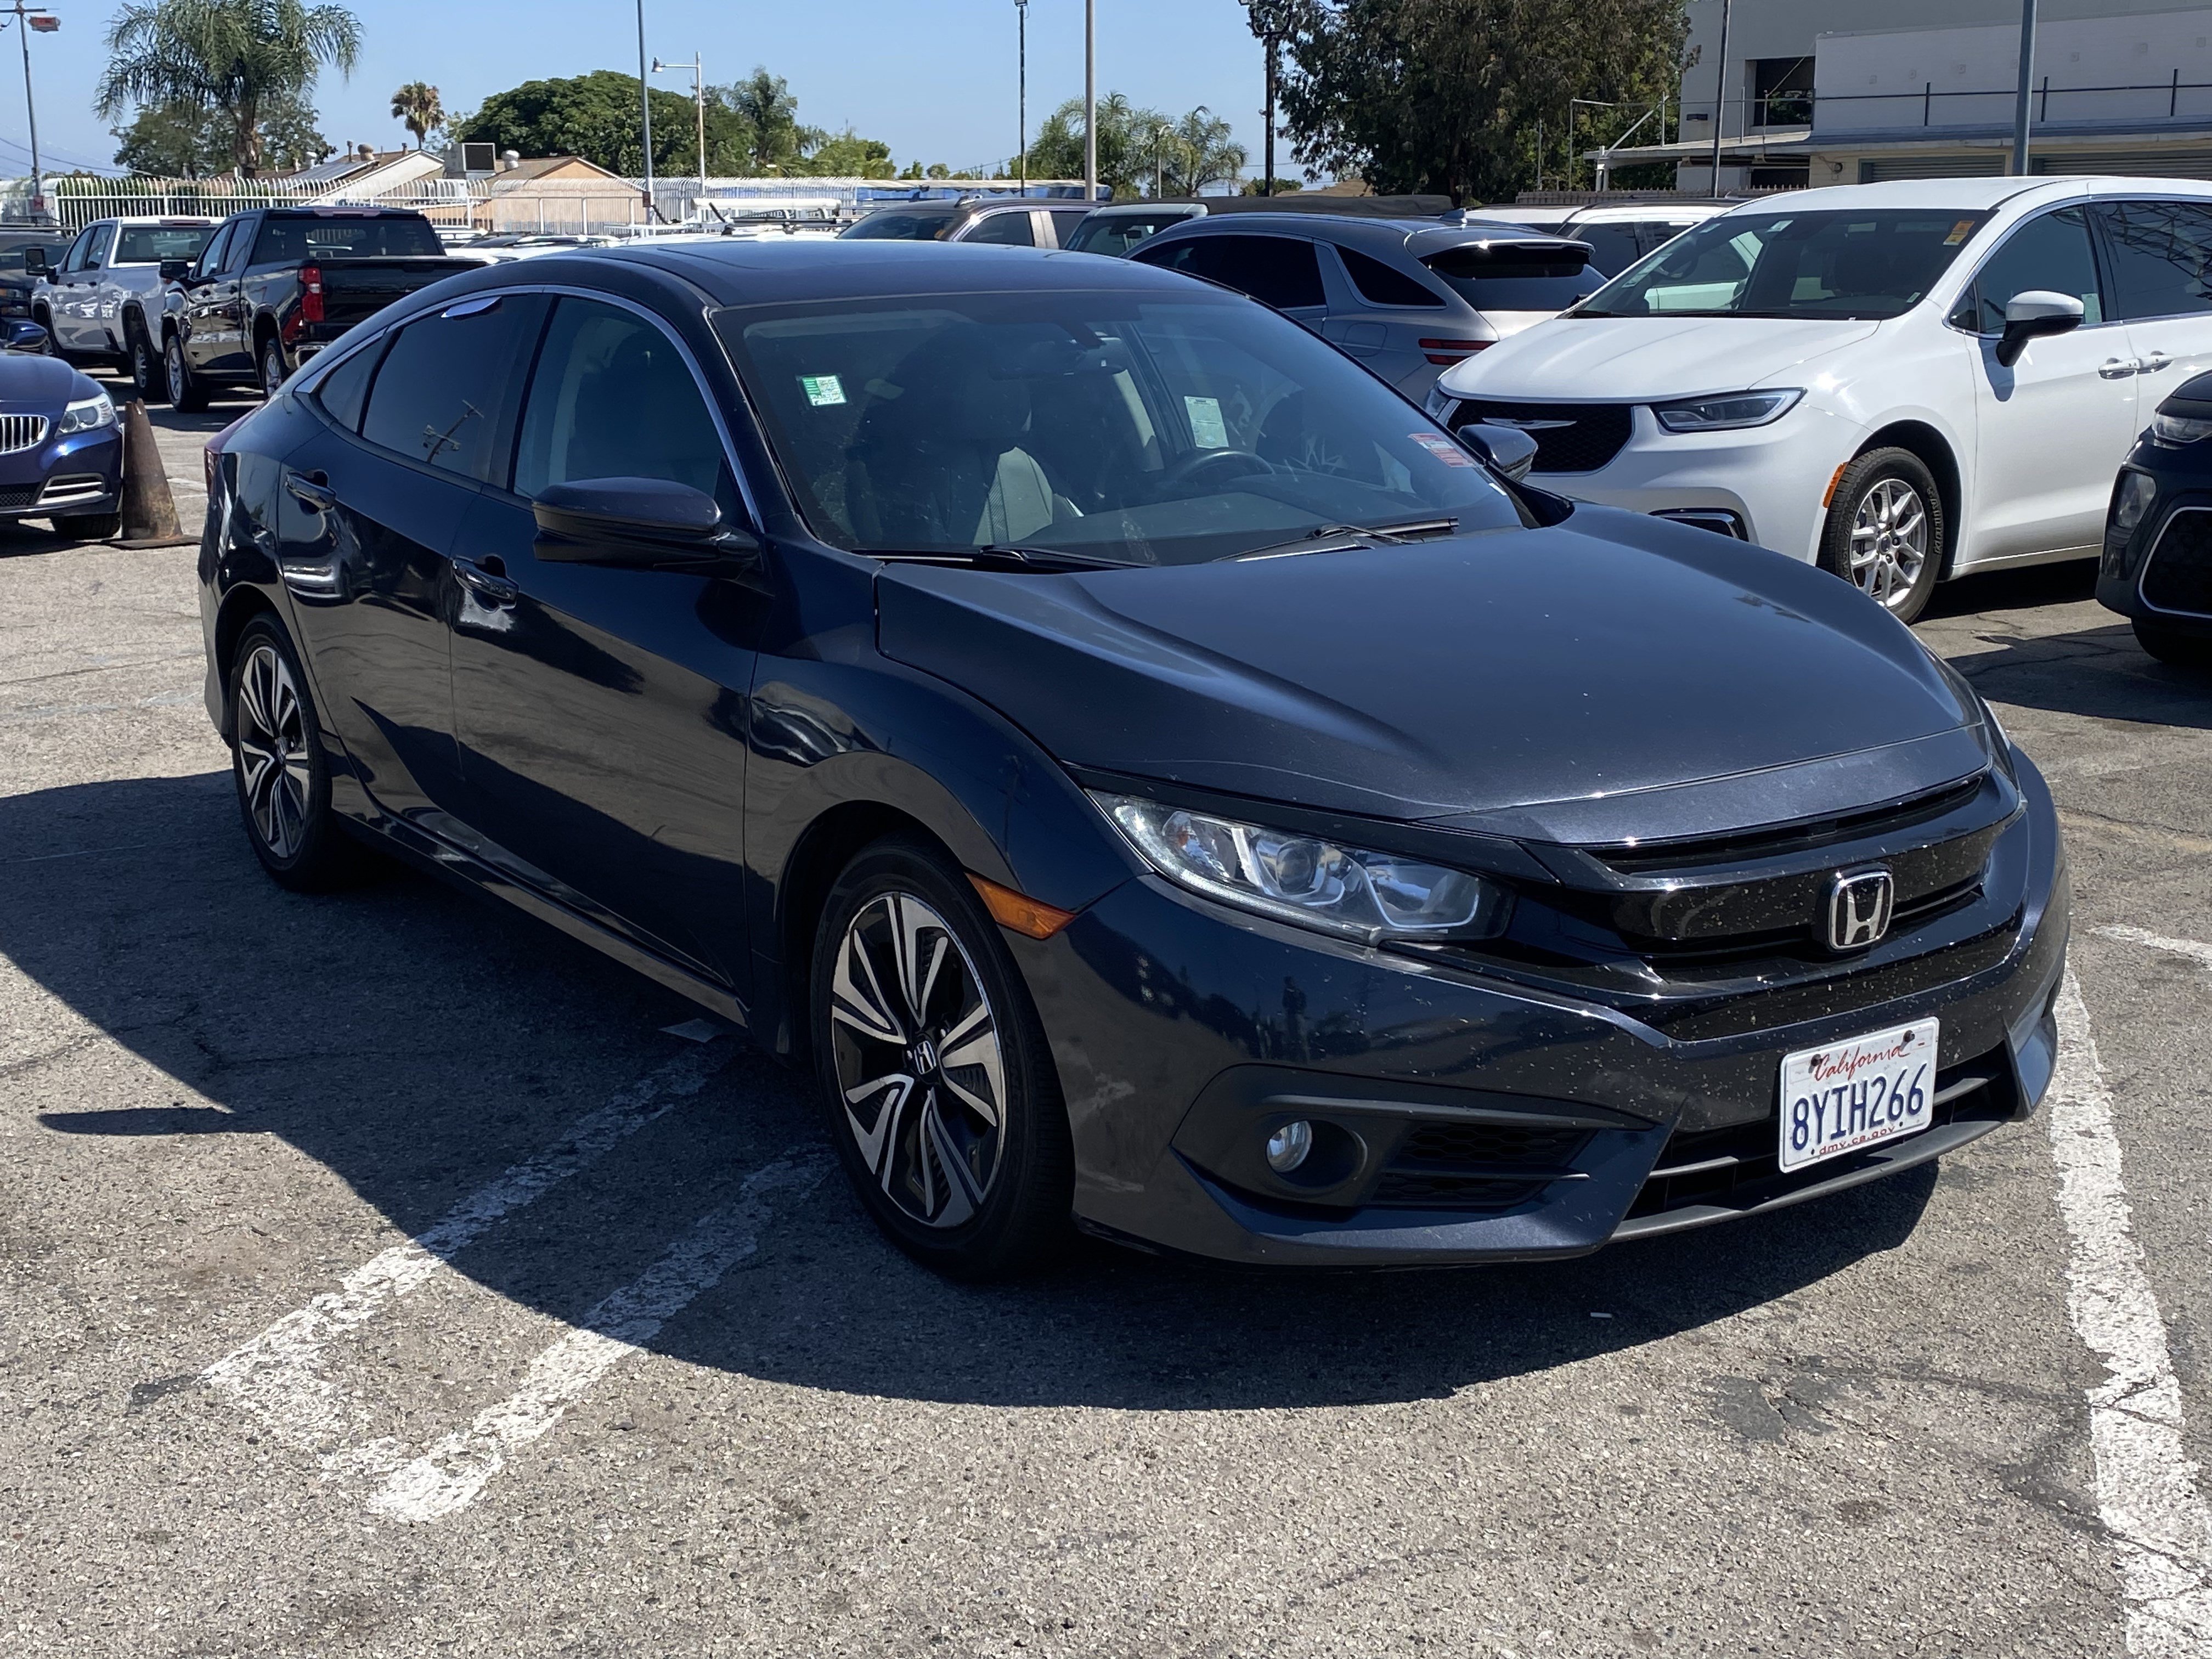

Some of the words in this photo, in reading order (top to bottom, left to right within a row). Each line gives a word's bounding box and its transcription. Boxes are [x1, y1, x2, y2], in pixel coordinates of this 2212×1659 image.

[1814, 1043, 1911, 1082] California
[1792, 1063, 1927, 1151] 8YIH266
[1819, 1126, 1895, 1155] dmv.ca.gov
